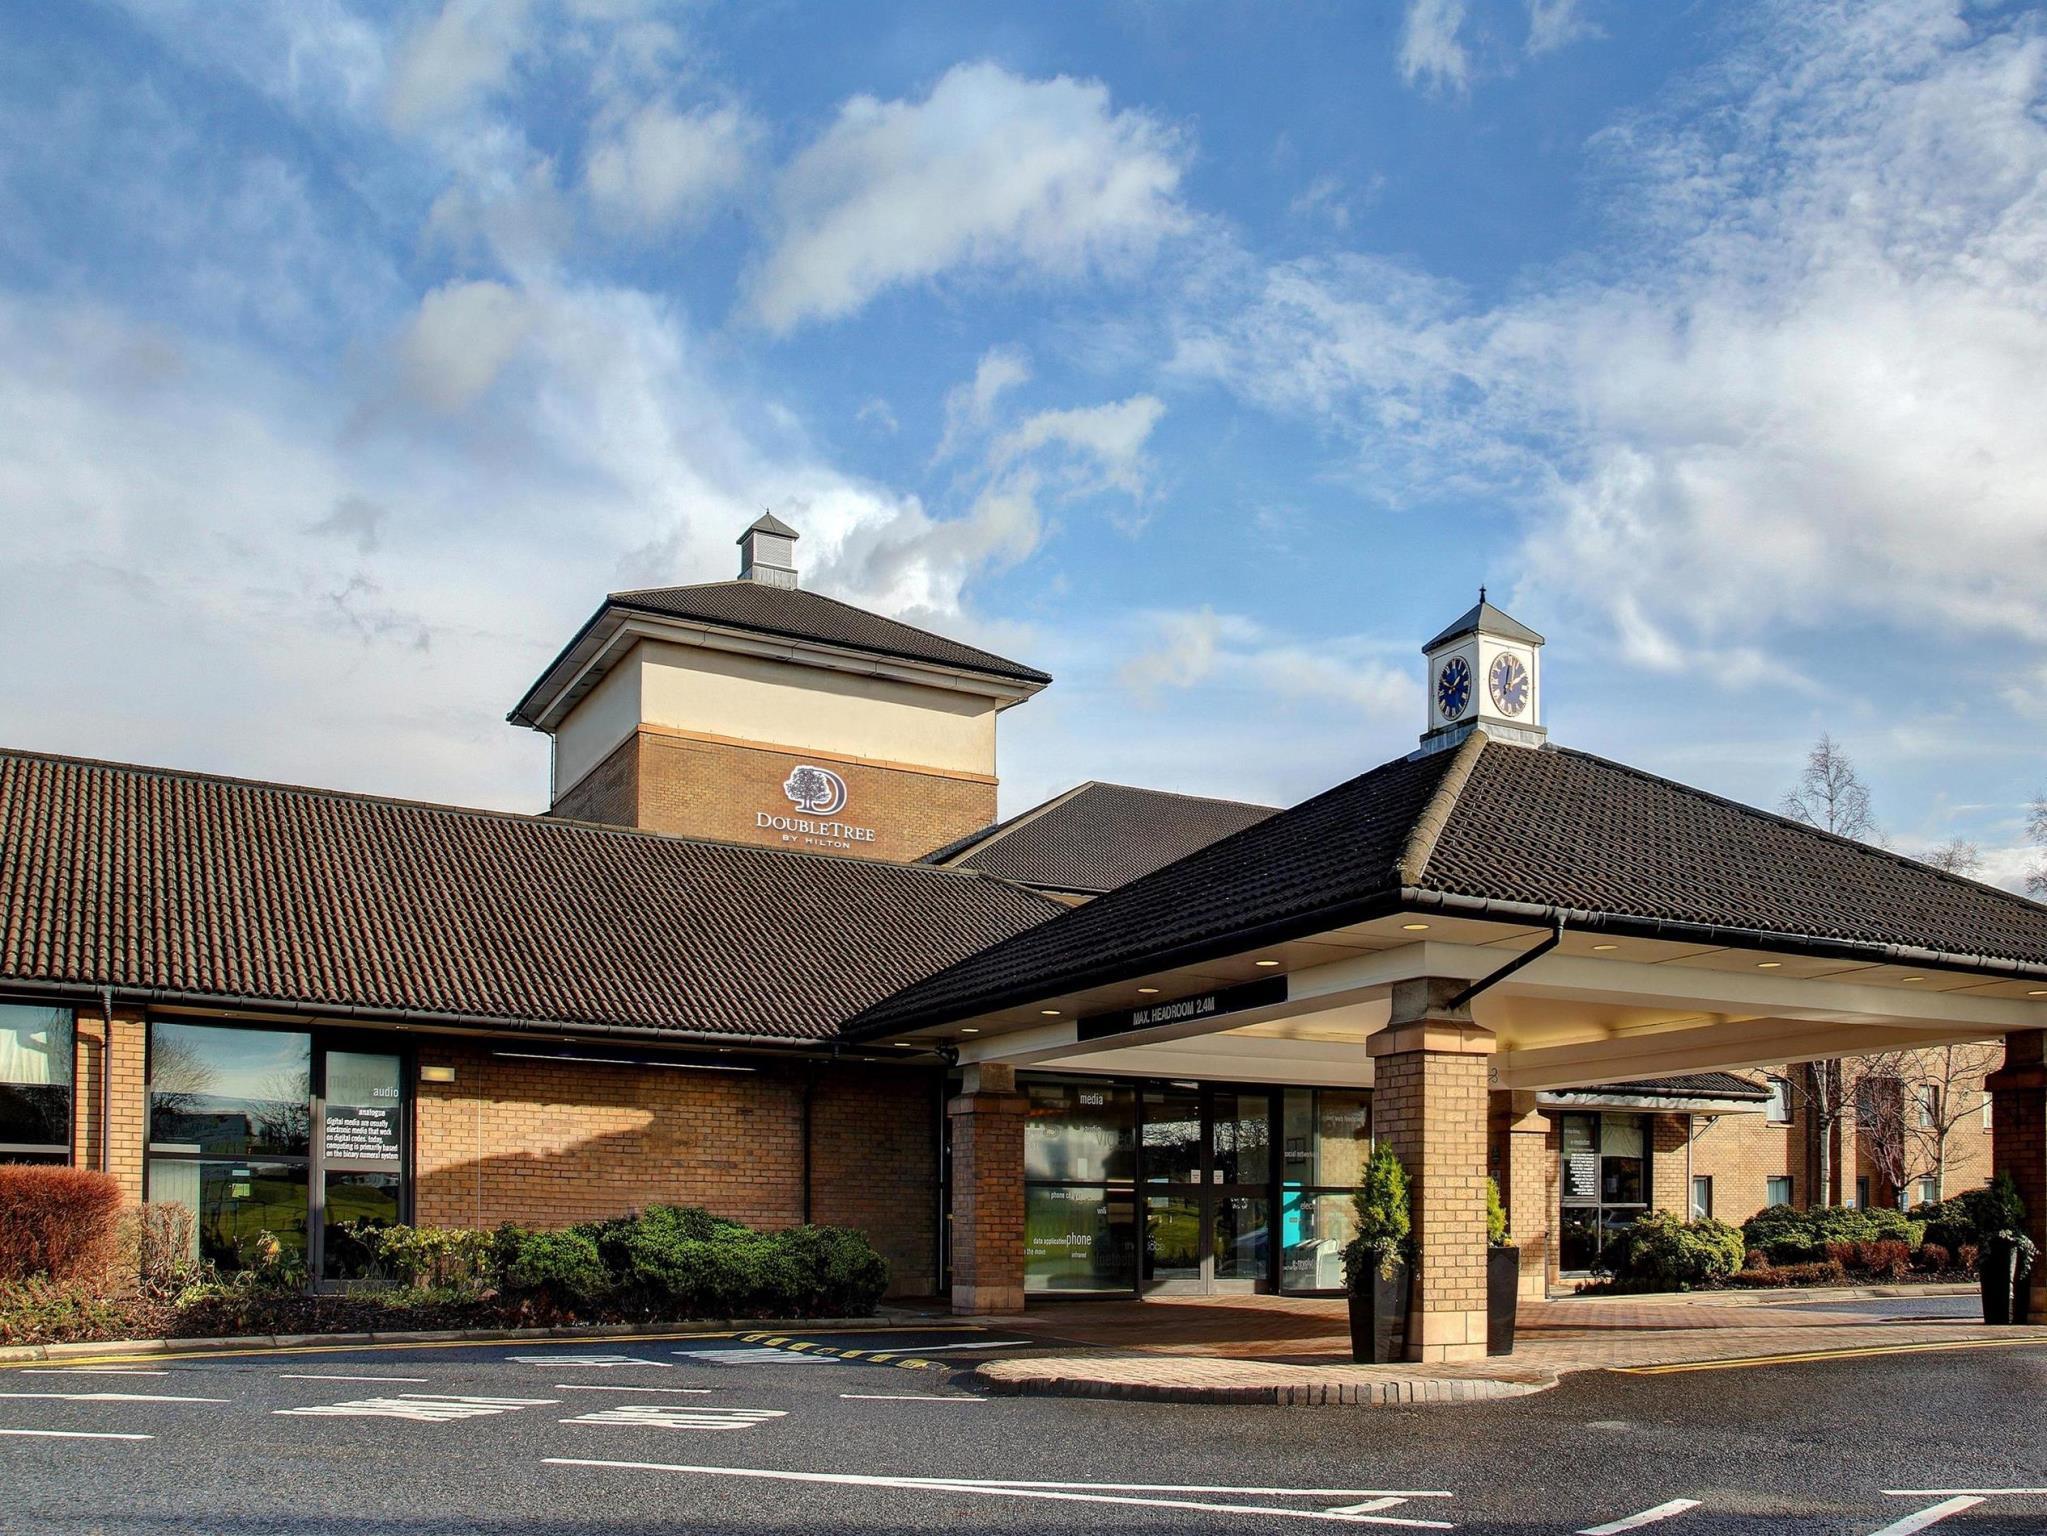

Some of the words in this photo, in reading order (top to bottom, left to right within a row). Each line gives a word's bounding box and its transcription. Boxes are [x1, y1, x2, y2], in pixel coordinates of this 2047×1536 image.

[782, 834, 798, 842] BY
[805, 837, 850, 849] HILTON
[1133, 1010, 1150, 1026] MAX.
[1152, 1001, 1194, 1023] HEADROOM
[1196, 996, 1215, 1013] 2.4M
[374, 1087, 399, 1097] audio
[1080, 1092, 1104, 1105] media
[359, 1109, 386, 1118] analogue
[326, 1117, 344, 1126] digital
[370, 1120, 388, 1128] usually
[352, 1127, 367, 1135] media
[333, 1134, 350, 1142] digital
[326, 1142, 353, 1151] computing
[360, 1143, 382, 1152] primarily
[343, 1150, 359, 1159] binary
[1066, 1232, 1092, 1248] phone
